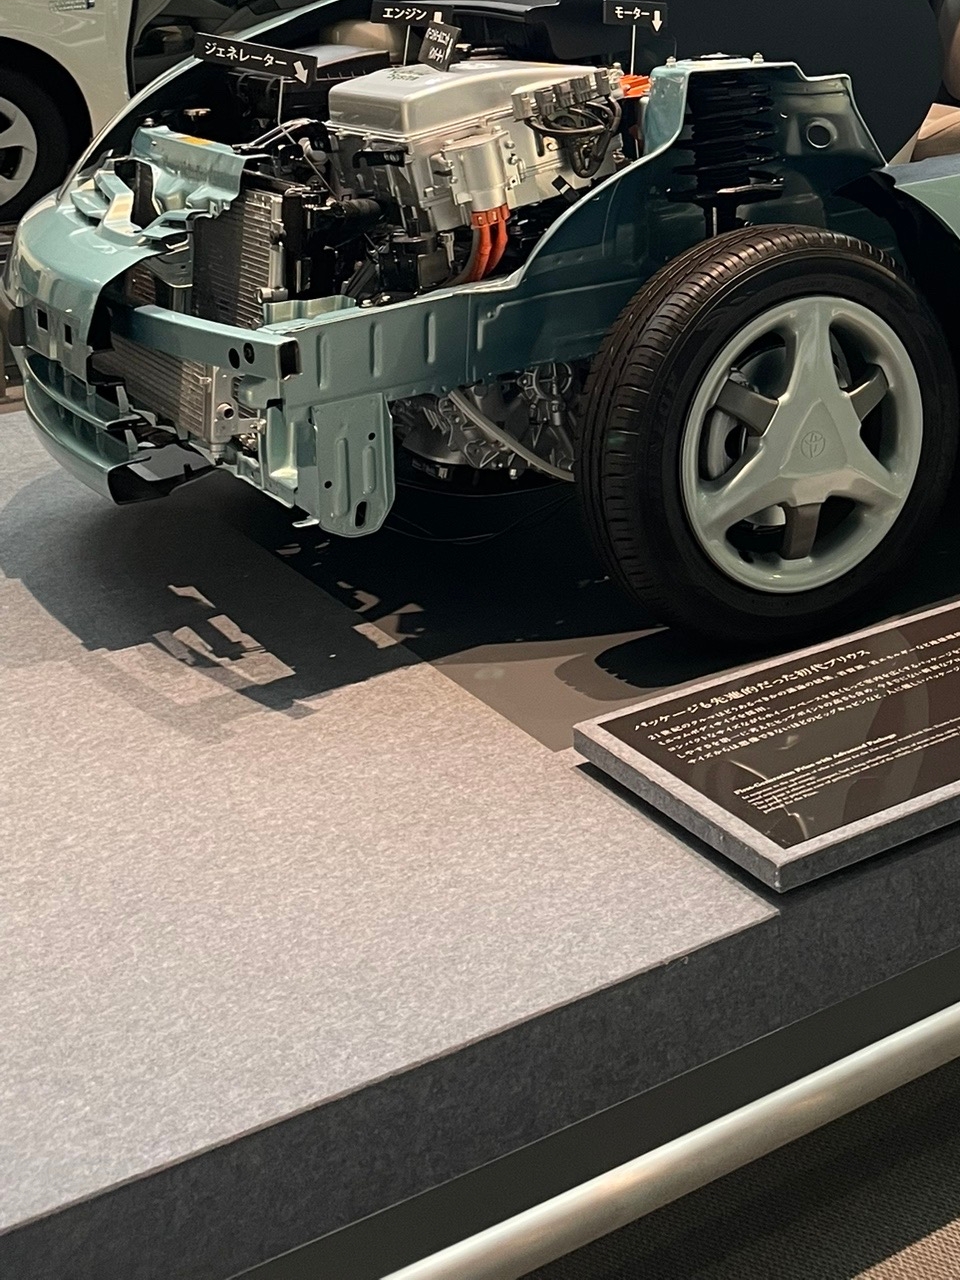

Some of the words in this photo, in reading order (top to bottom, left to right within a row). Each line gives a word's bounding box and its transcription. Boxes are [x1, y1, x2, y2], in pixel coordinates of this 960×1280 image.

[382, 7, 427, 20] エンジン
[615, 6, 650, 20] モーター
[204, 41, 287, 67] ジェネレーター
